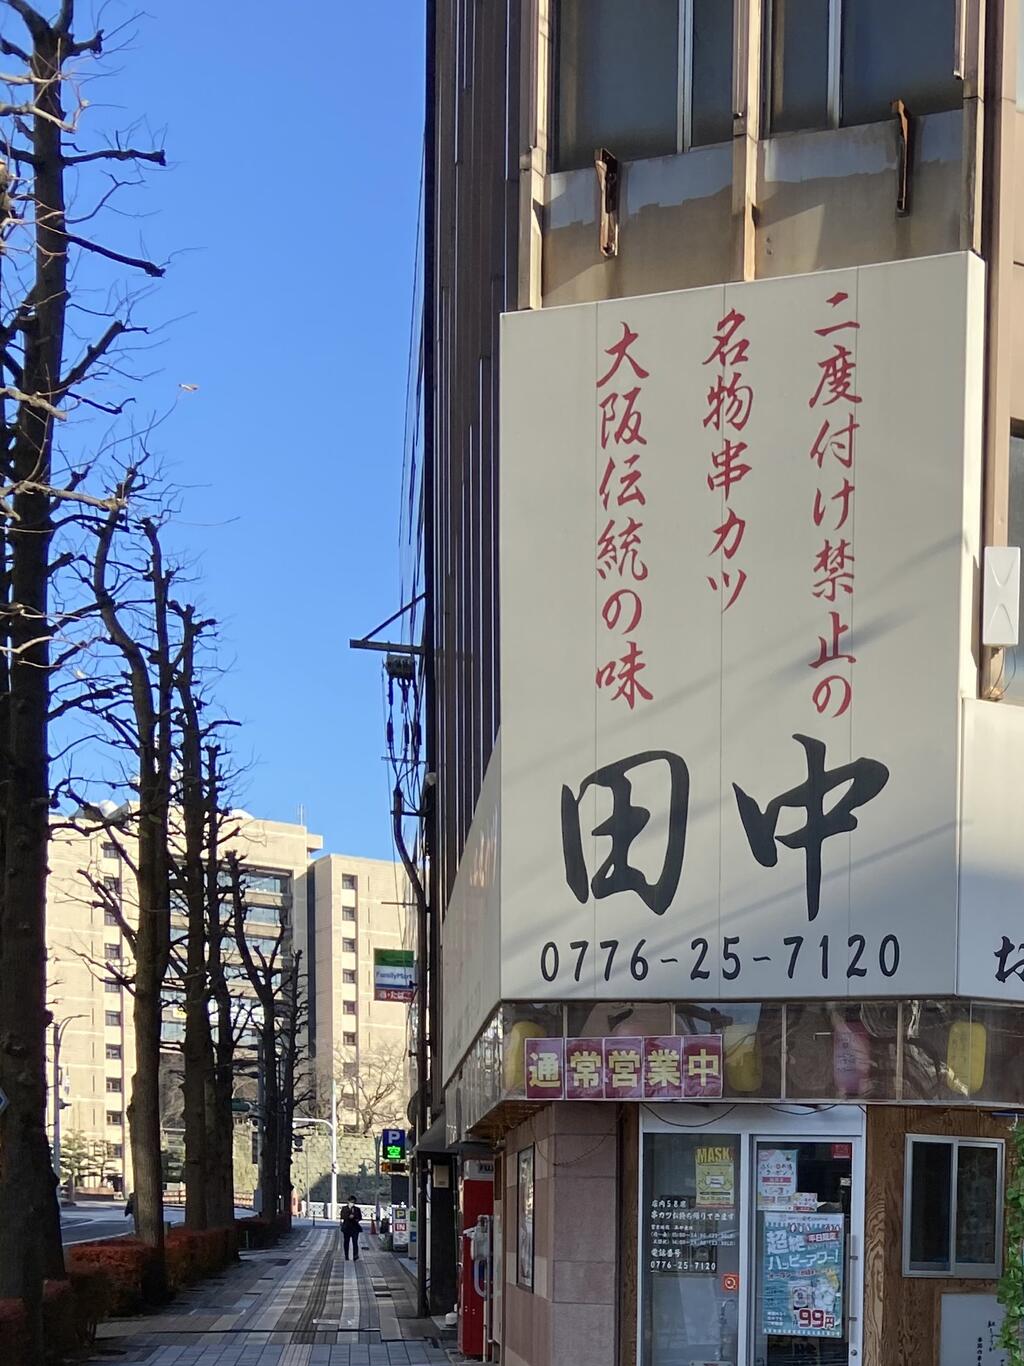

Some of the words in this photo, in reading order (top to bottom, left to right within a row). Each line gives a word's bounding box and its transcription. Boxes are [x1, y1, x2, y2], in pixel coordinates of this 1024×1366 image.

[596, 321, 654, 711] 大阪伝統の味
[702, 308, 754, 613] 名物串カツ
[808, 291, 864, 719] 二度付け禁止の
[561, 733, 890, 922] 田中
[540, 934, 900, 982] 0776-25-7120
[529, 1050, 721, 1088] 通常営業中
[388, 1131, 400, 1144] P
[650, 1260, 716, 1271] 0776-25-7120
